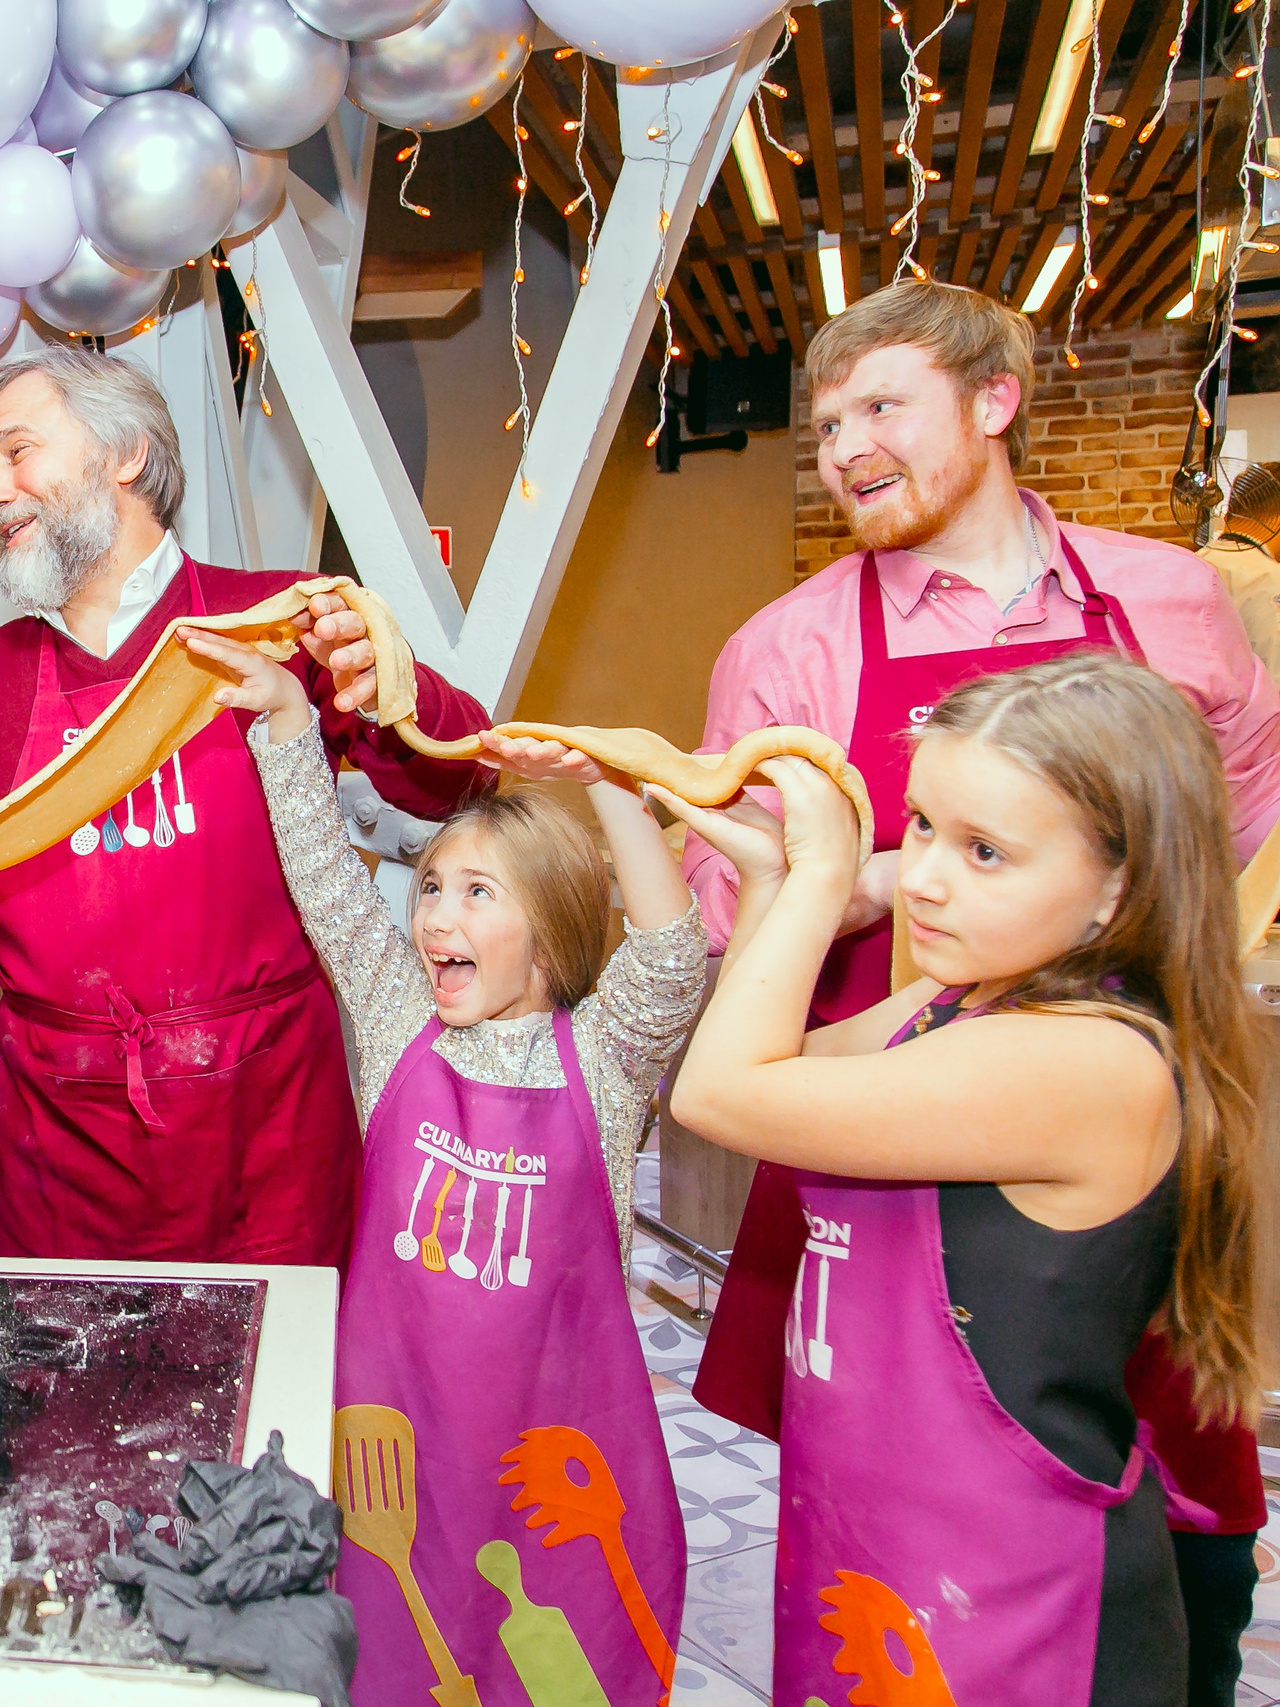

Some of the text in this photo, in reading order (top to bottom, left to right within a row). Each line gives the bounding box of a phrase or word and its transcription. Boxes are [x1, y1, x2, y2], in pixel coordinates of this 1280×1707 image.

[418, 1121, 547, 1173] CULINARY ON
[810, 1215, 852, 1245] ON
